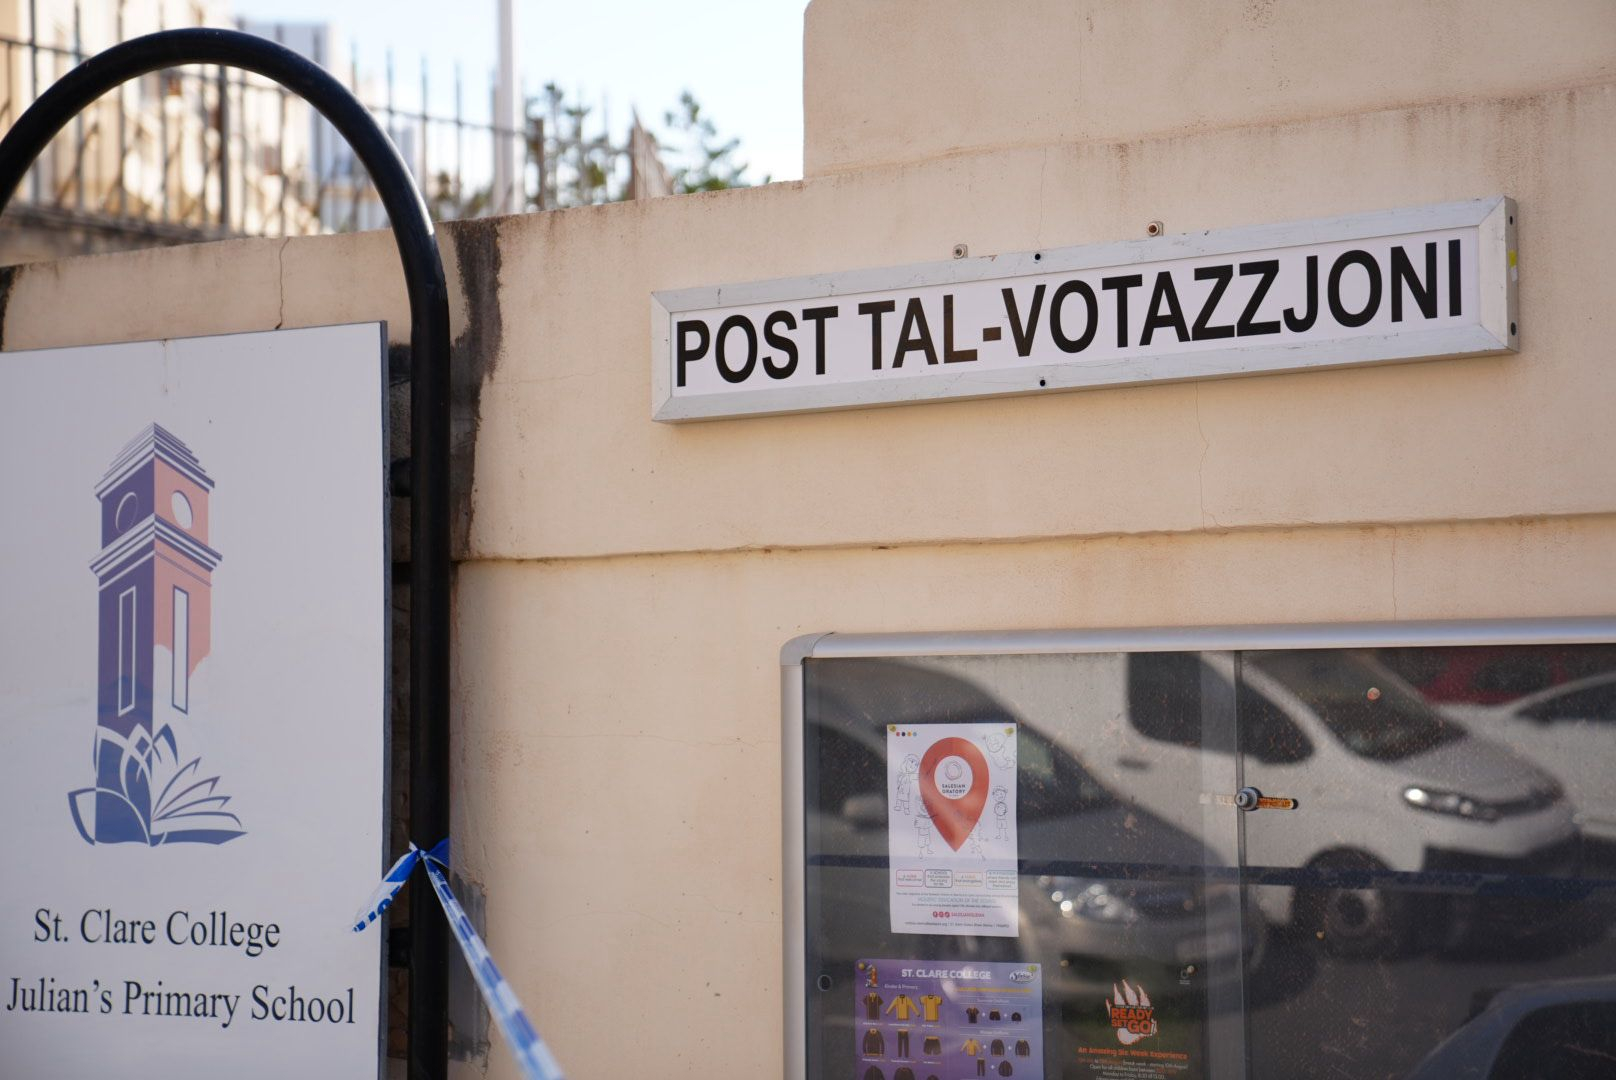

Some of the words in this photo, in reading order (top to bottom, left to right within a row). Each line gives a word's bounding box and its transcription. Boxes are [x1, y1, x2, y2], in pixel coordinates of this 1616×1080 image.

[676, 305, 839, 388] POST
[858, 238, 1462, 371] TAL-VOTAZZJONI
[34, 907, 69, 943] St.
[80, 908, 156, 945] Clare
[166, 910, 281, 957] College
[901, 969, 914, 978] ST.
[916, 969, 948, 979] CLARE
[949, 970, 992, 980] COLLEGE
[6, 976, 113, 1014] Julian's
[122, 980, 241, 1028] Primary
[251, 984, 356, 1024] School
[1111, 1007, 1153, 1020] READY
[1111, 1020, 1127, 1028] SET
